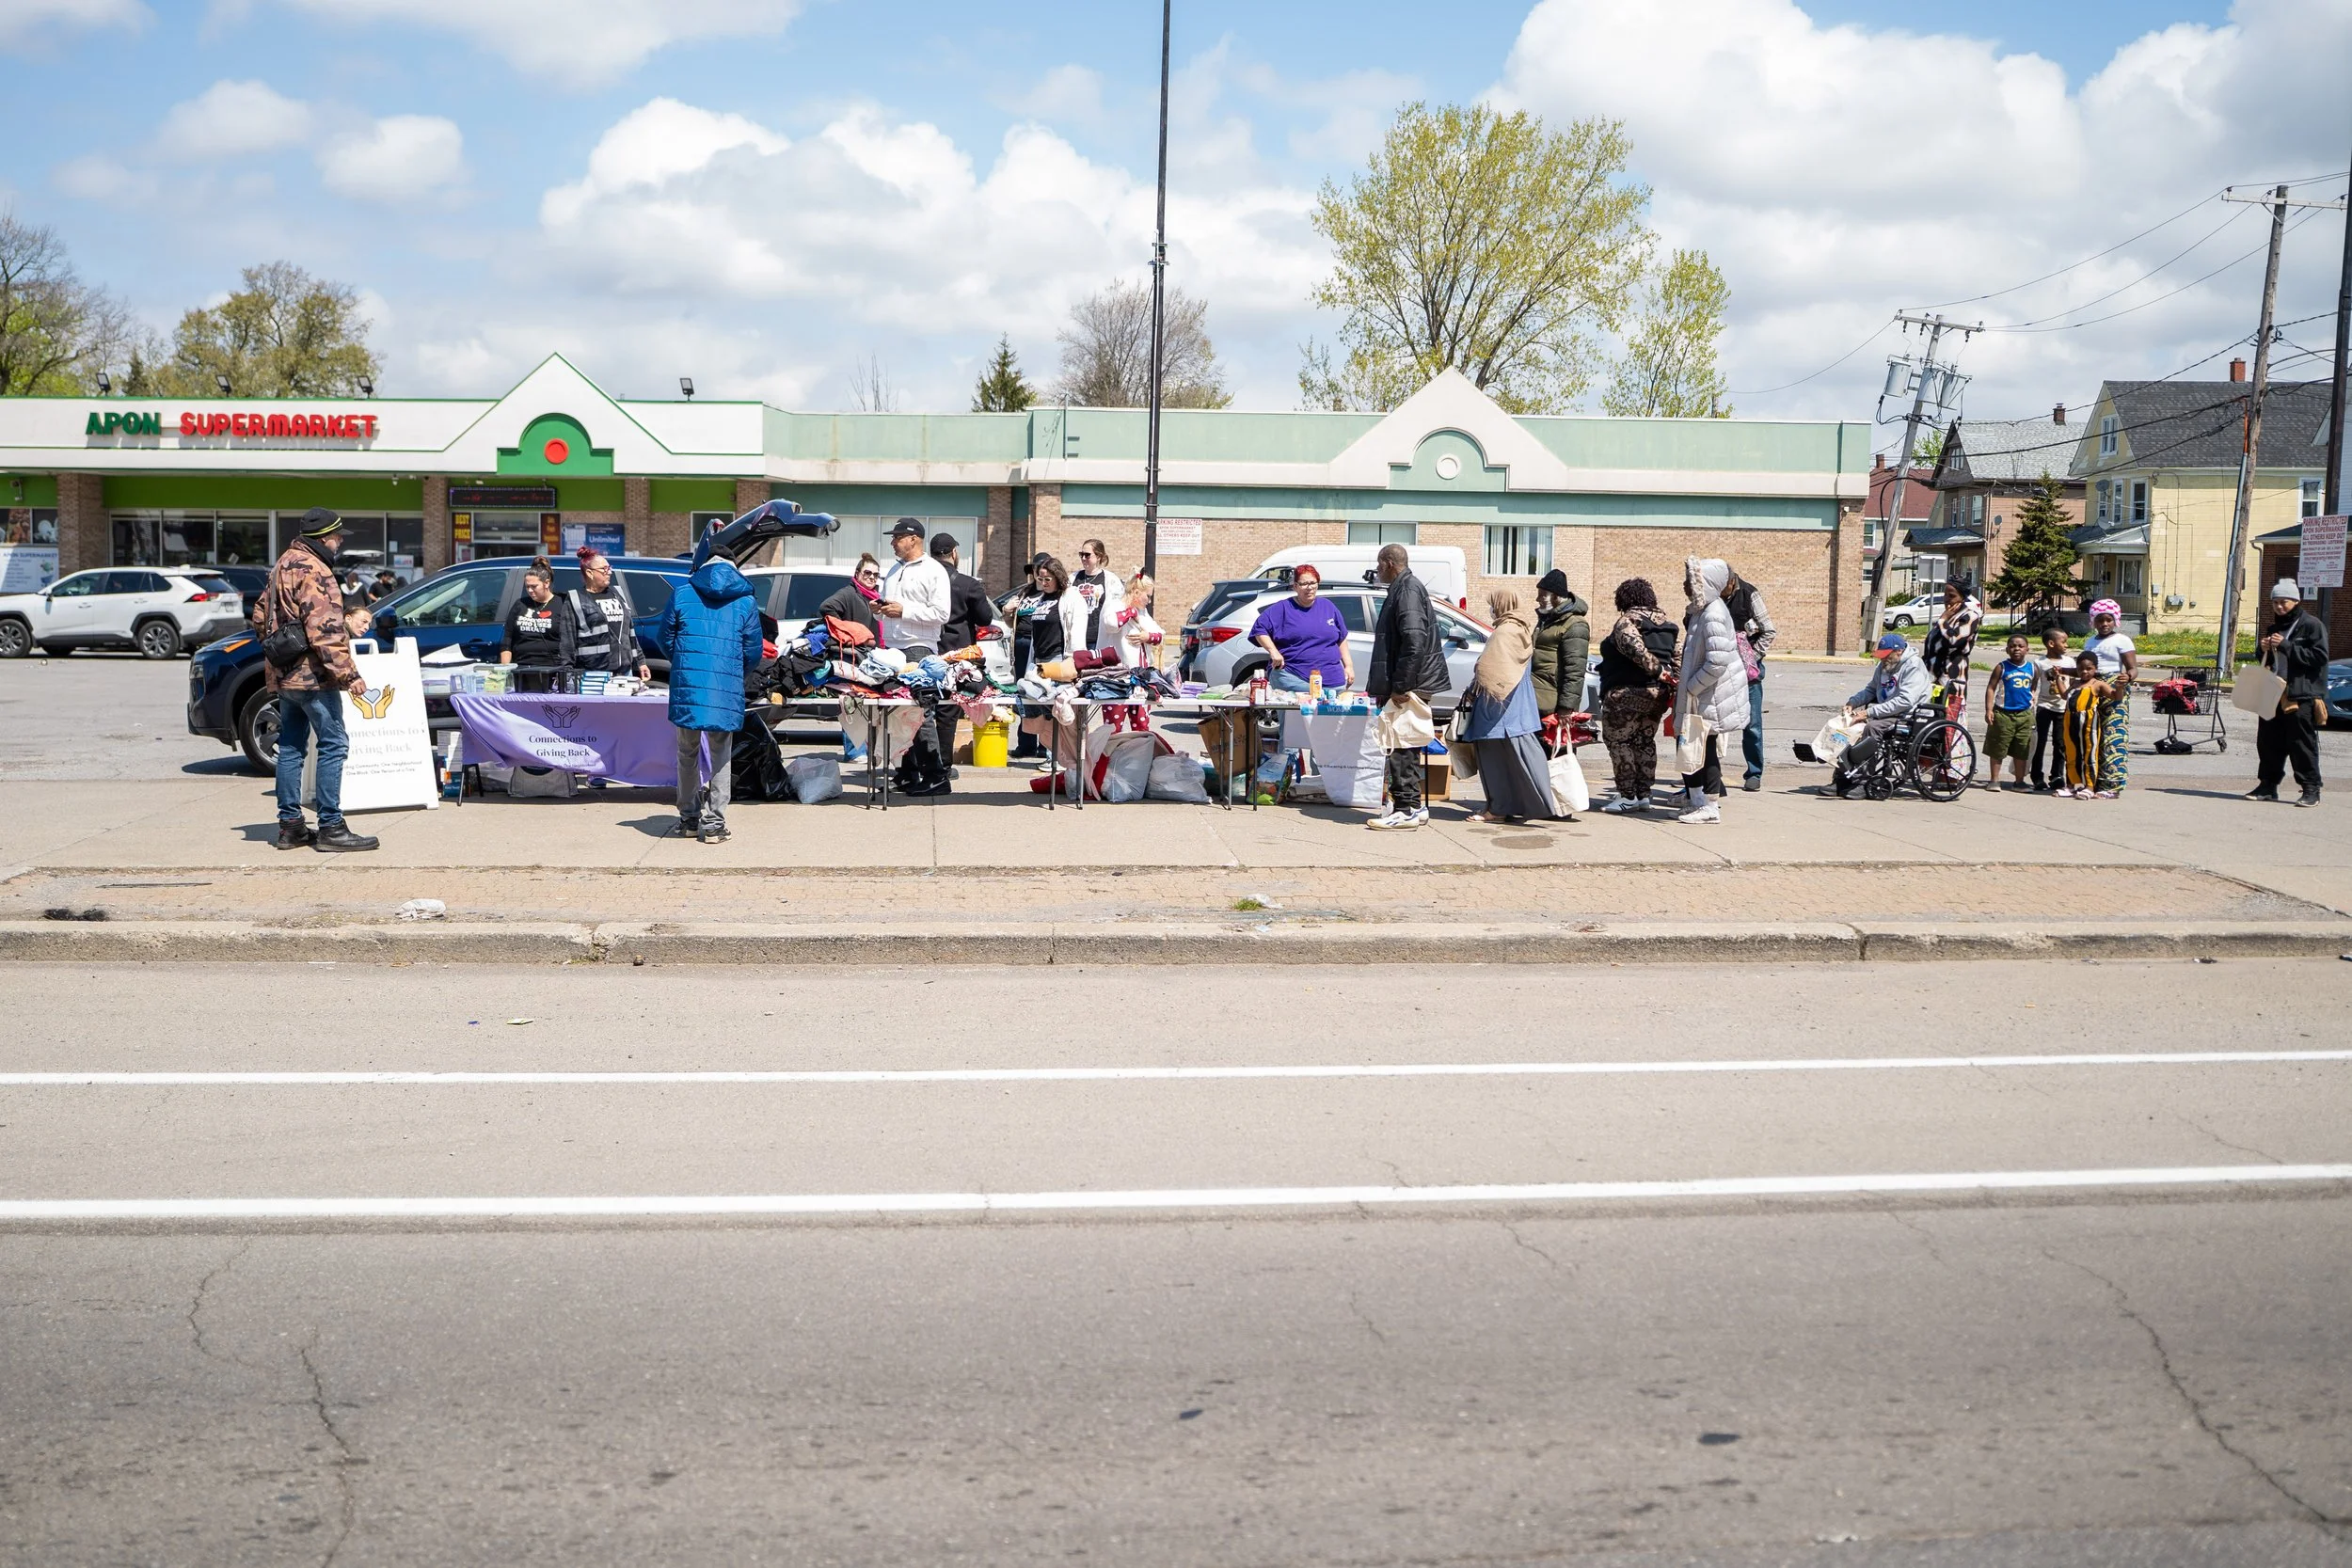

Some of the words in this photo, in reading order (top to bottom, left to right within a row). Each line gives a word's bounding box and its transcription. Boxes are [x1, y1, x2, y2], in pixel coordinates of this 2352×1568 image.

[85, 412, 161, 436] APON
[179, 412, 378, 438] SUPERMARKET
[2302, 517, 2321, 527] PARKING
[2321, 515, 2347, 526] RESTRICTED
[2013, 678, 2030, 689] 30
[529, 735, 586, 744] Connections
[588, 735, 597, 743] to
[385, 743, 412, 752] Back
[536, 749, 566, 758] Giving
[568, 748, 590, 757] Back
